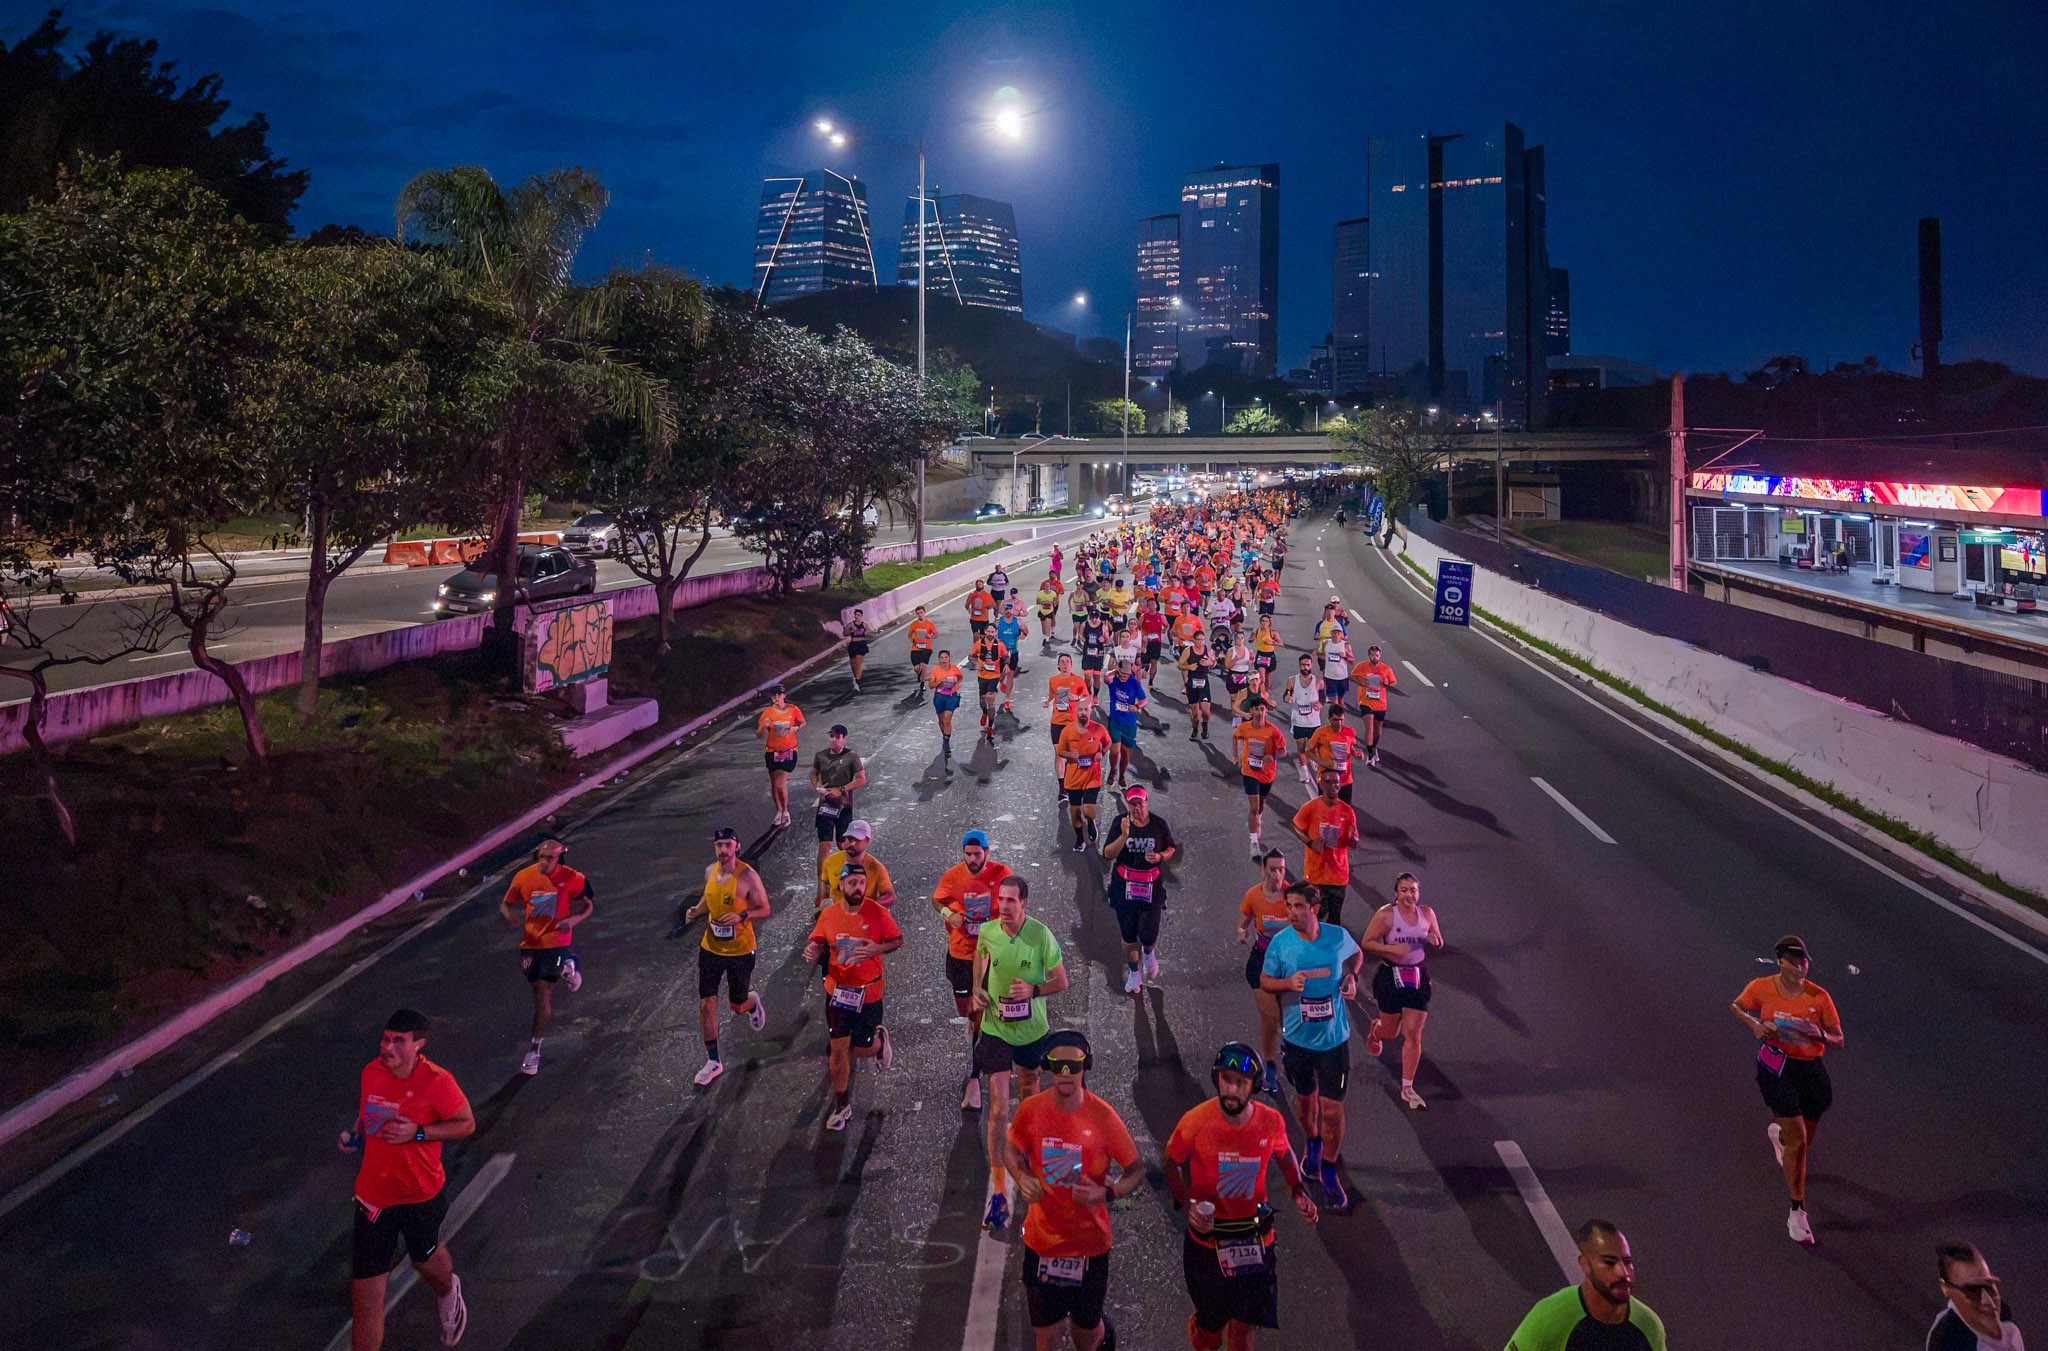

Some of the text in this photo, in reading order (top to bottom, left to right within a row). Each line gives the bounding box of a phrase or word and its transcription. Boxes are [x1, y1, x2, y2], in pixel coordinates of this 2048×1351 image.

[1440, 605, 1464, 616] 100
[1126, 837, 1156, 849] CWB
[1051, 1258, 1080, 1270] 6737
